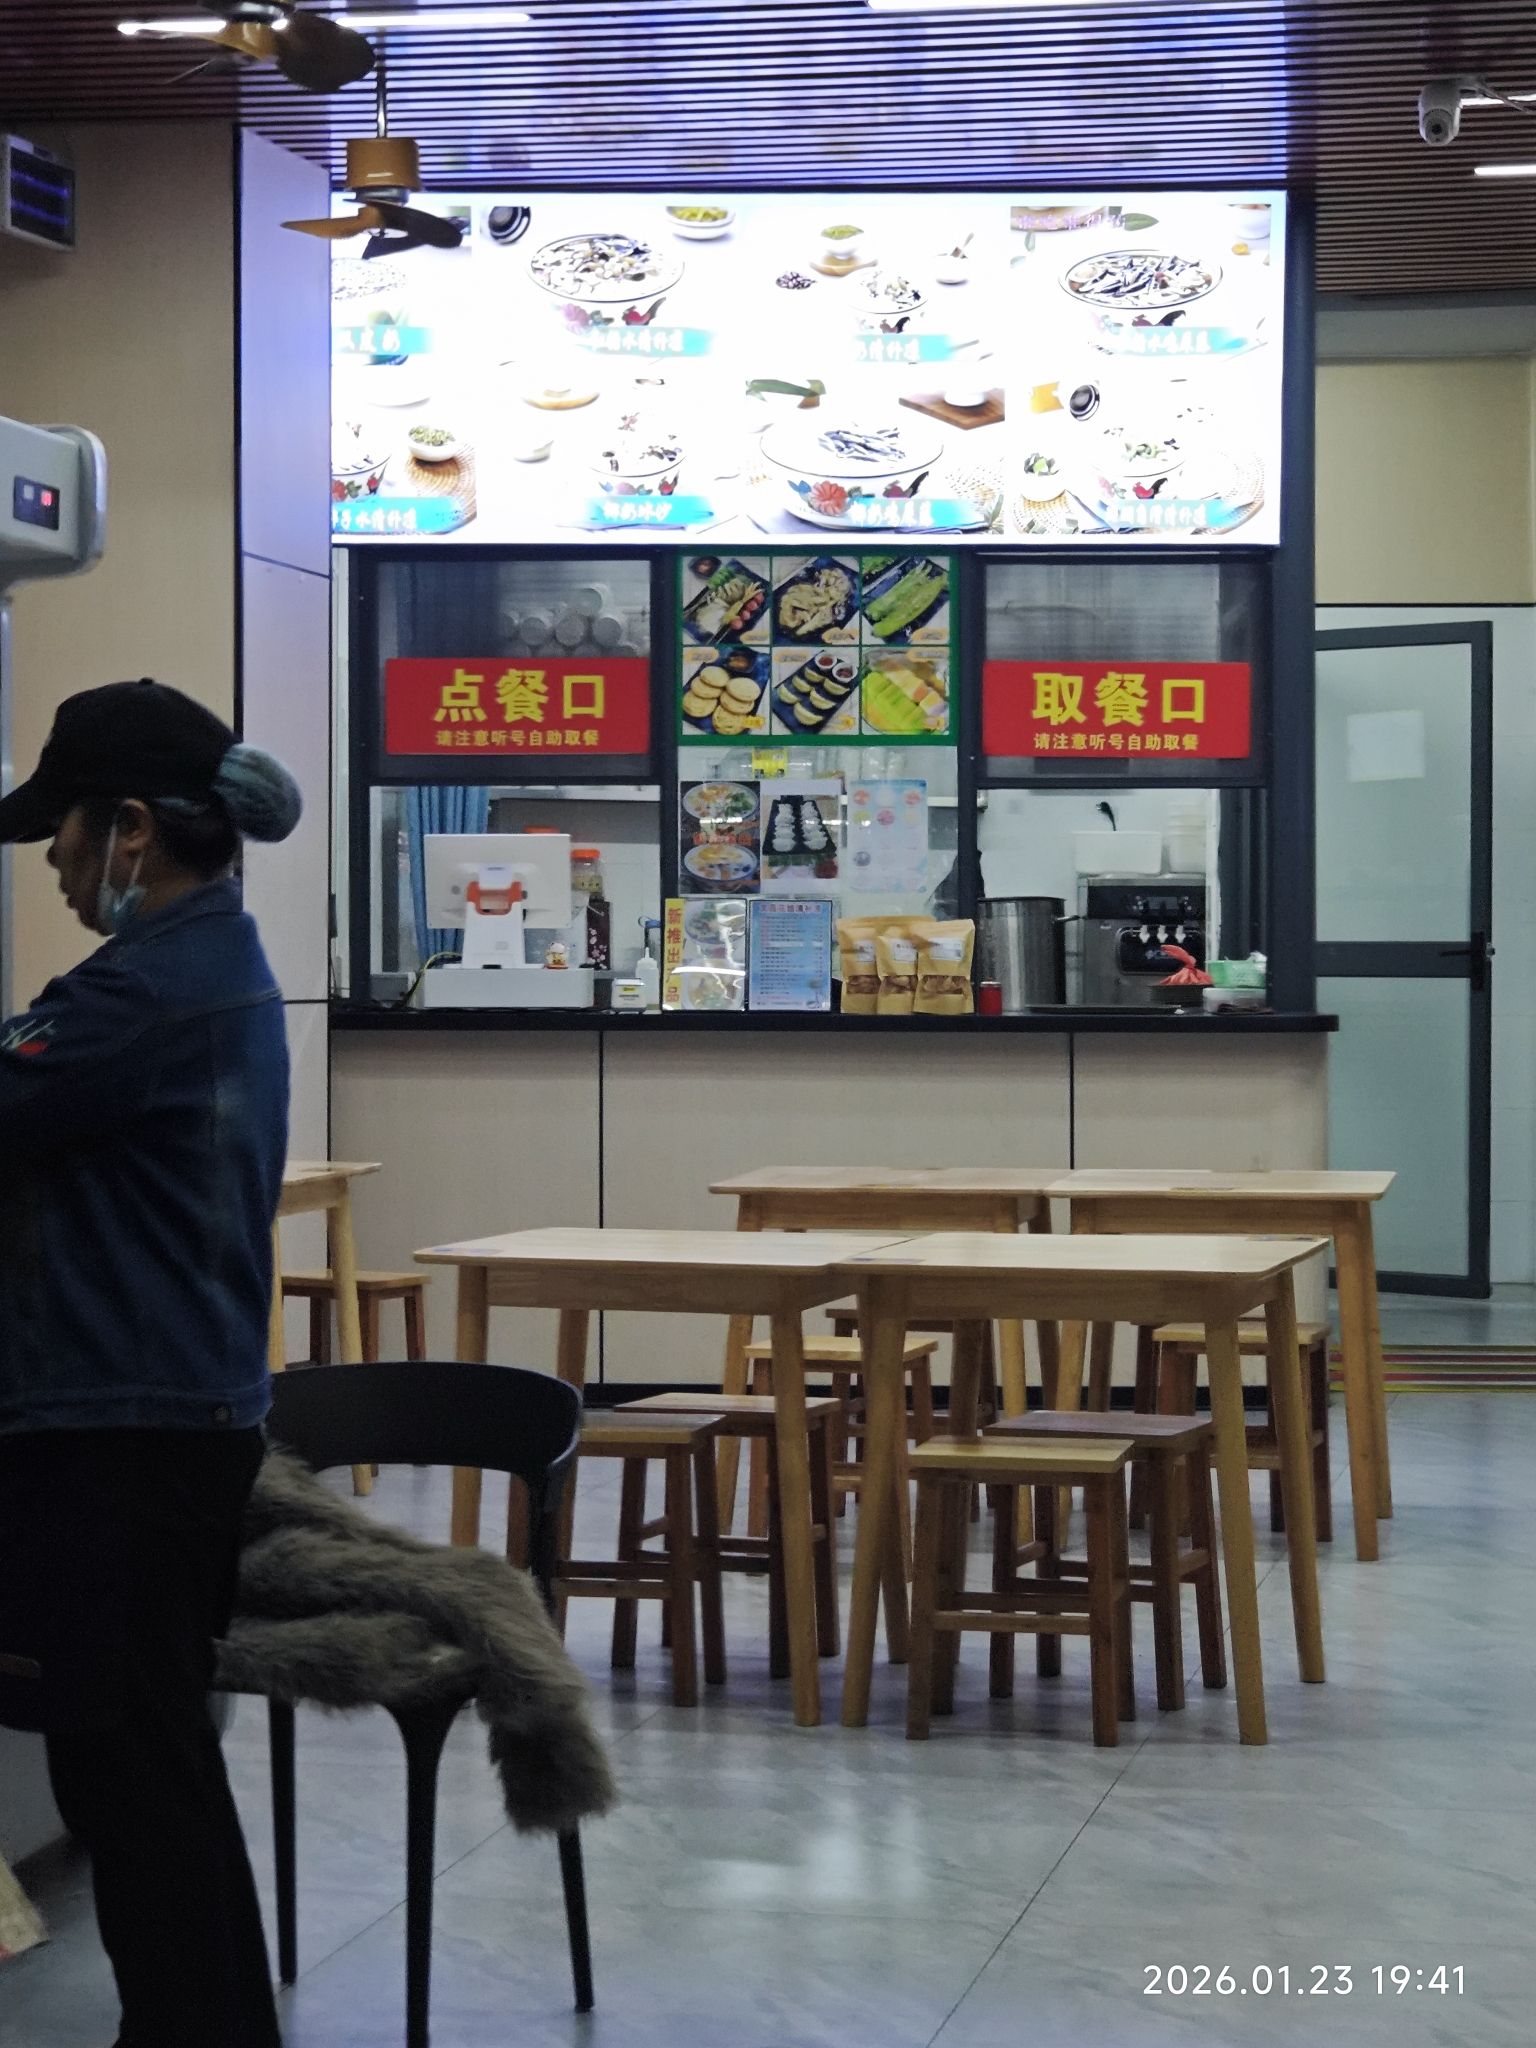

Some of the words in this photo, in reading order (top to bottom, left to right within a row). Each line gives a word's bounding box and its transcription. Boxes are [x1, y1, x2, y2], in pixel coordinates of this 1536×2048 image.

[433, 668, 605, 723] 点餐口
[1031, 671, 1207, 726] 取餐口
[435, 729, 600, 747] 请注意听号自助取餐
[1033, 732, 1199, 752] 请注意听号自助取餐
